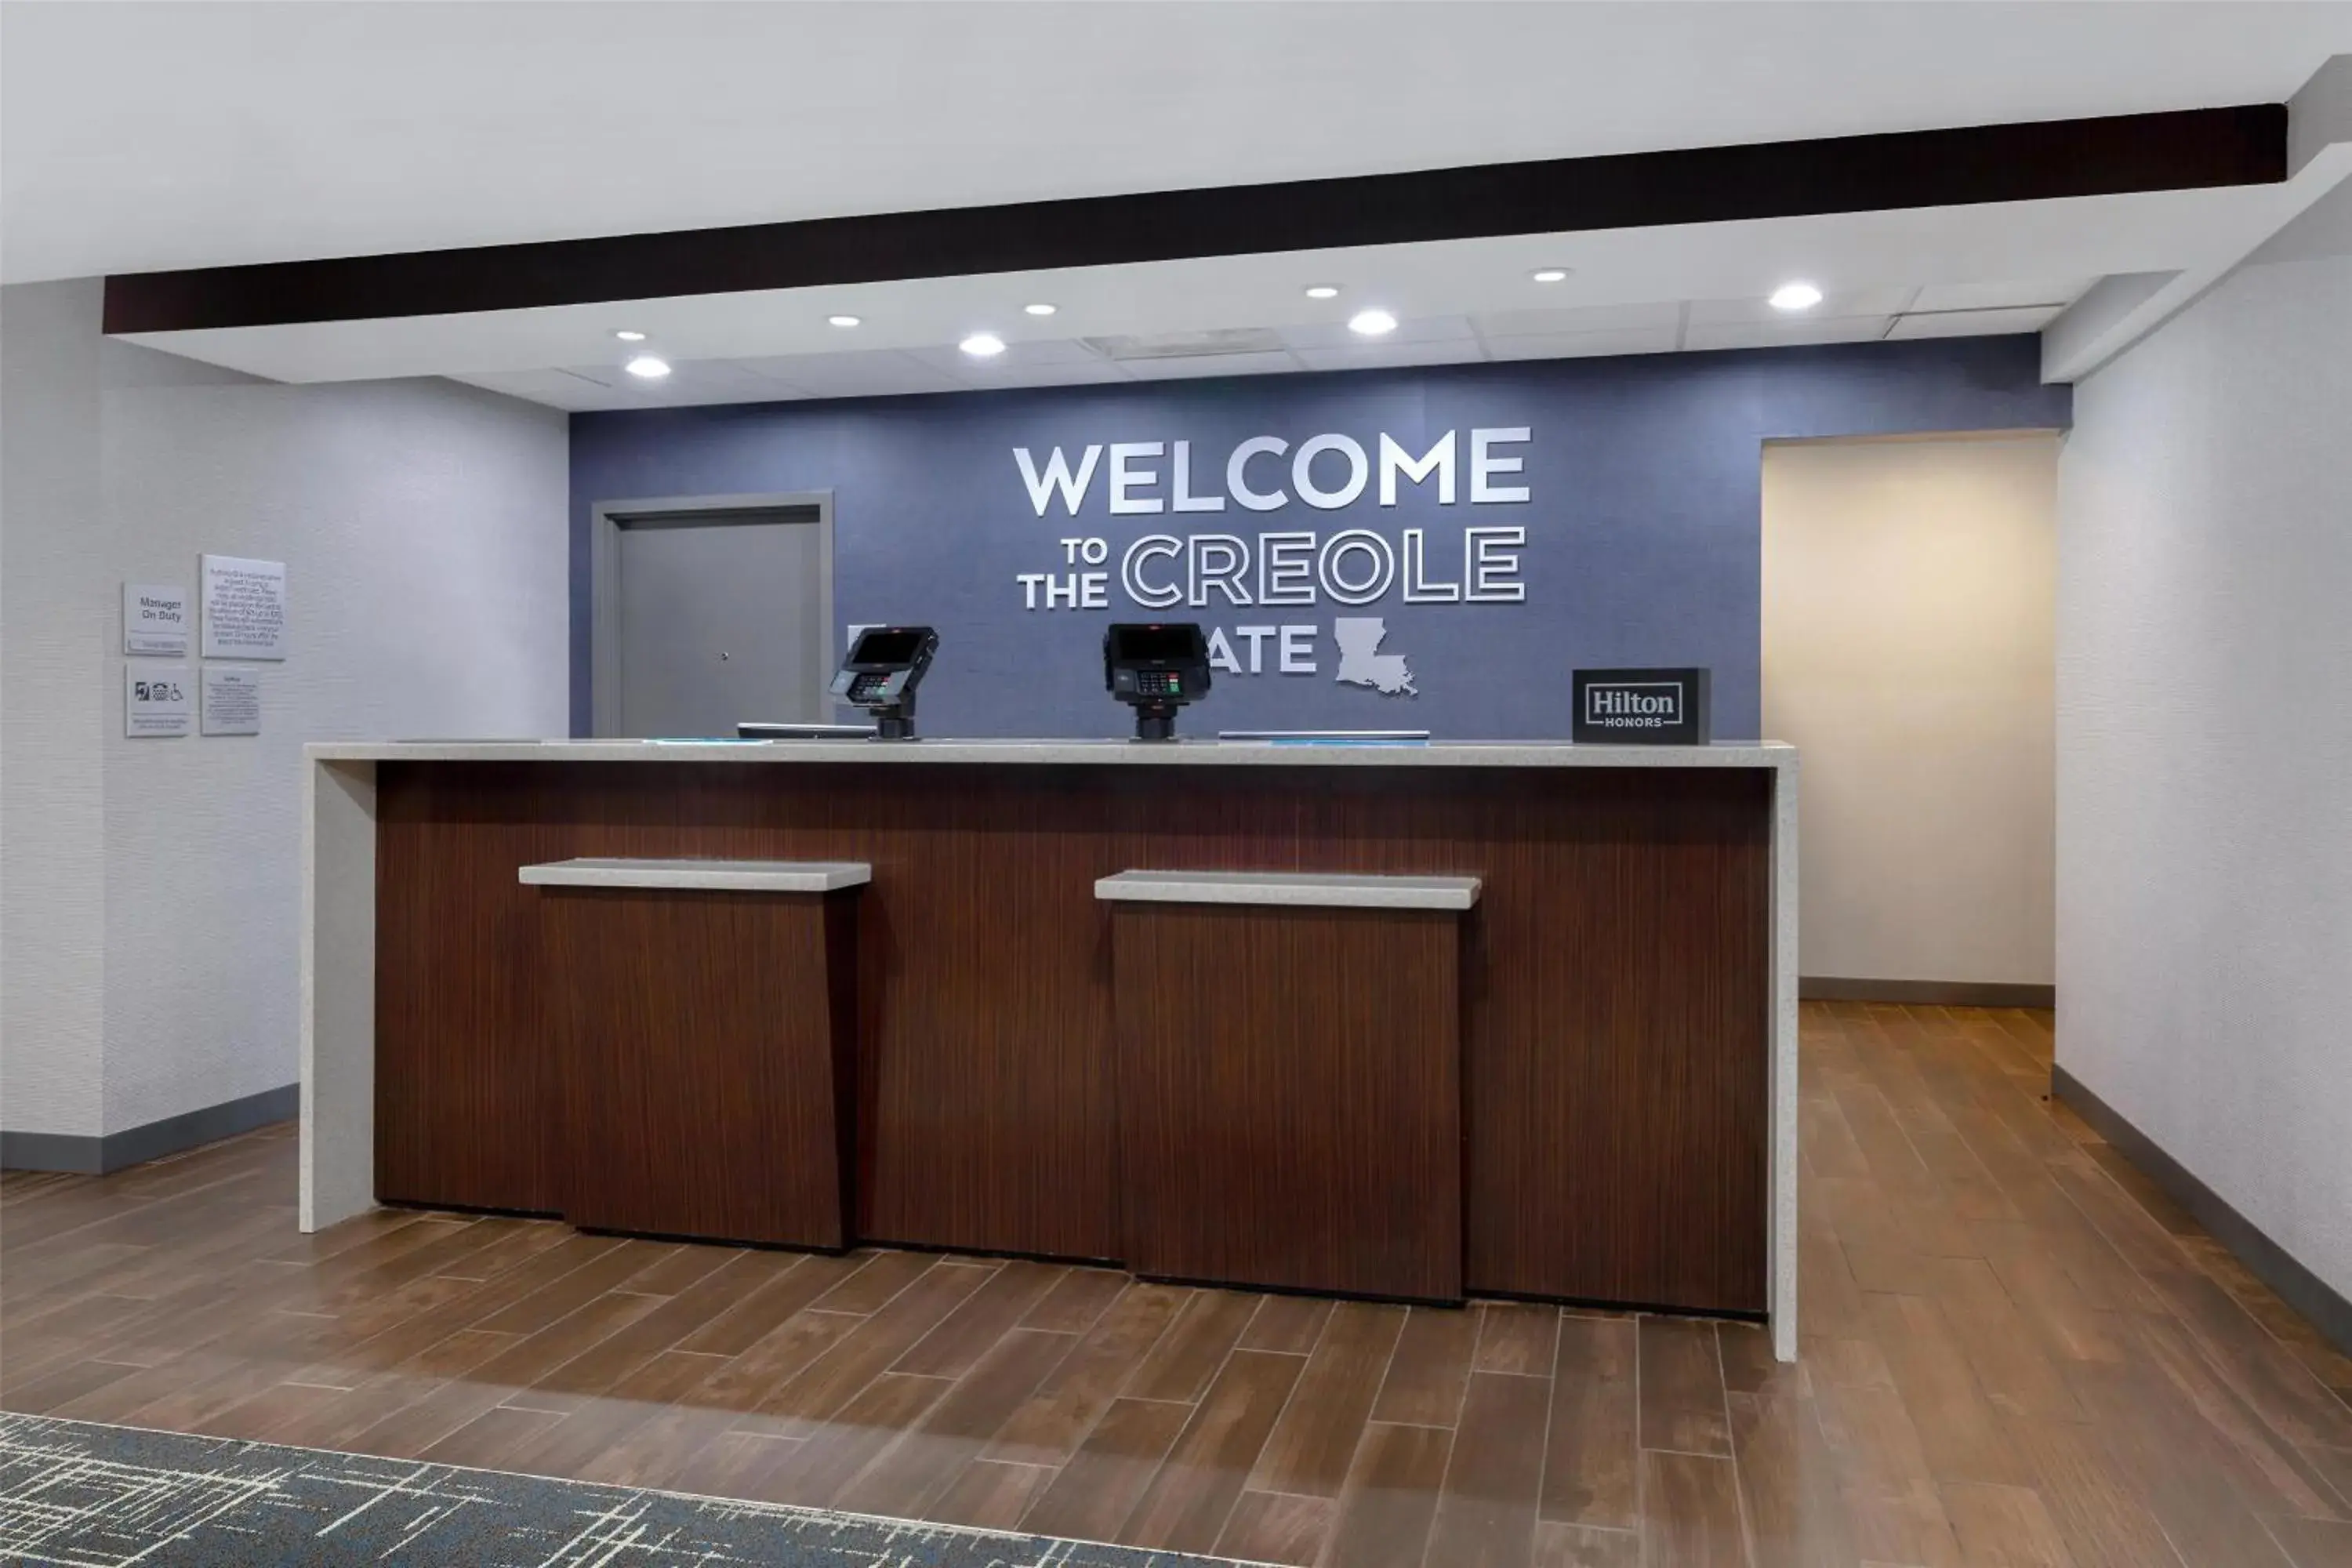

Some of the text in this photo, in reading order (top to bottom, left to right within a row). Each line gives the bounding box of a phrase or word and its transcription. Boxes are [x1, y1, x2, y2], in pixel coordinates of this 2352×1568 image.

[1012, 426, 1532, 517] WELCOME
[1060, 537, 1109, 564] TO
[1016, 526, 1526, 610] THE CREOLE
[140, 597, 182, 611] Manager
[142, 609, 183, 623] On Duty
[1208, 625, 1319, 673] ATE
[1592, 691, 1675, 714] Hilton
[1605, 717, 1663, 728] HONORS
